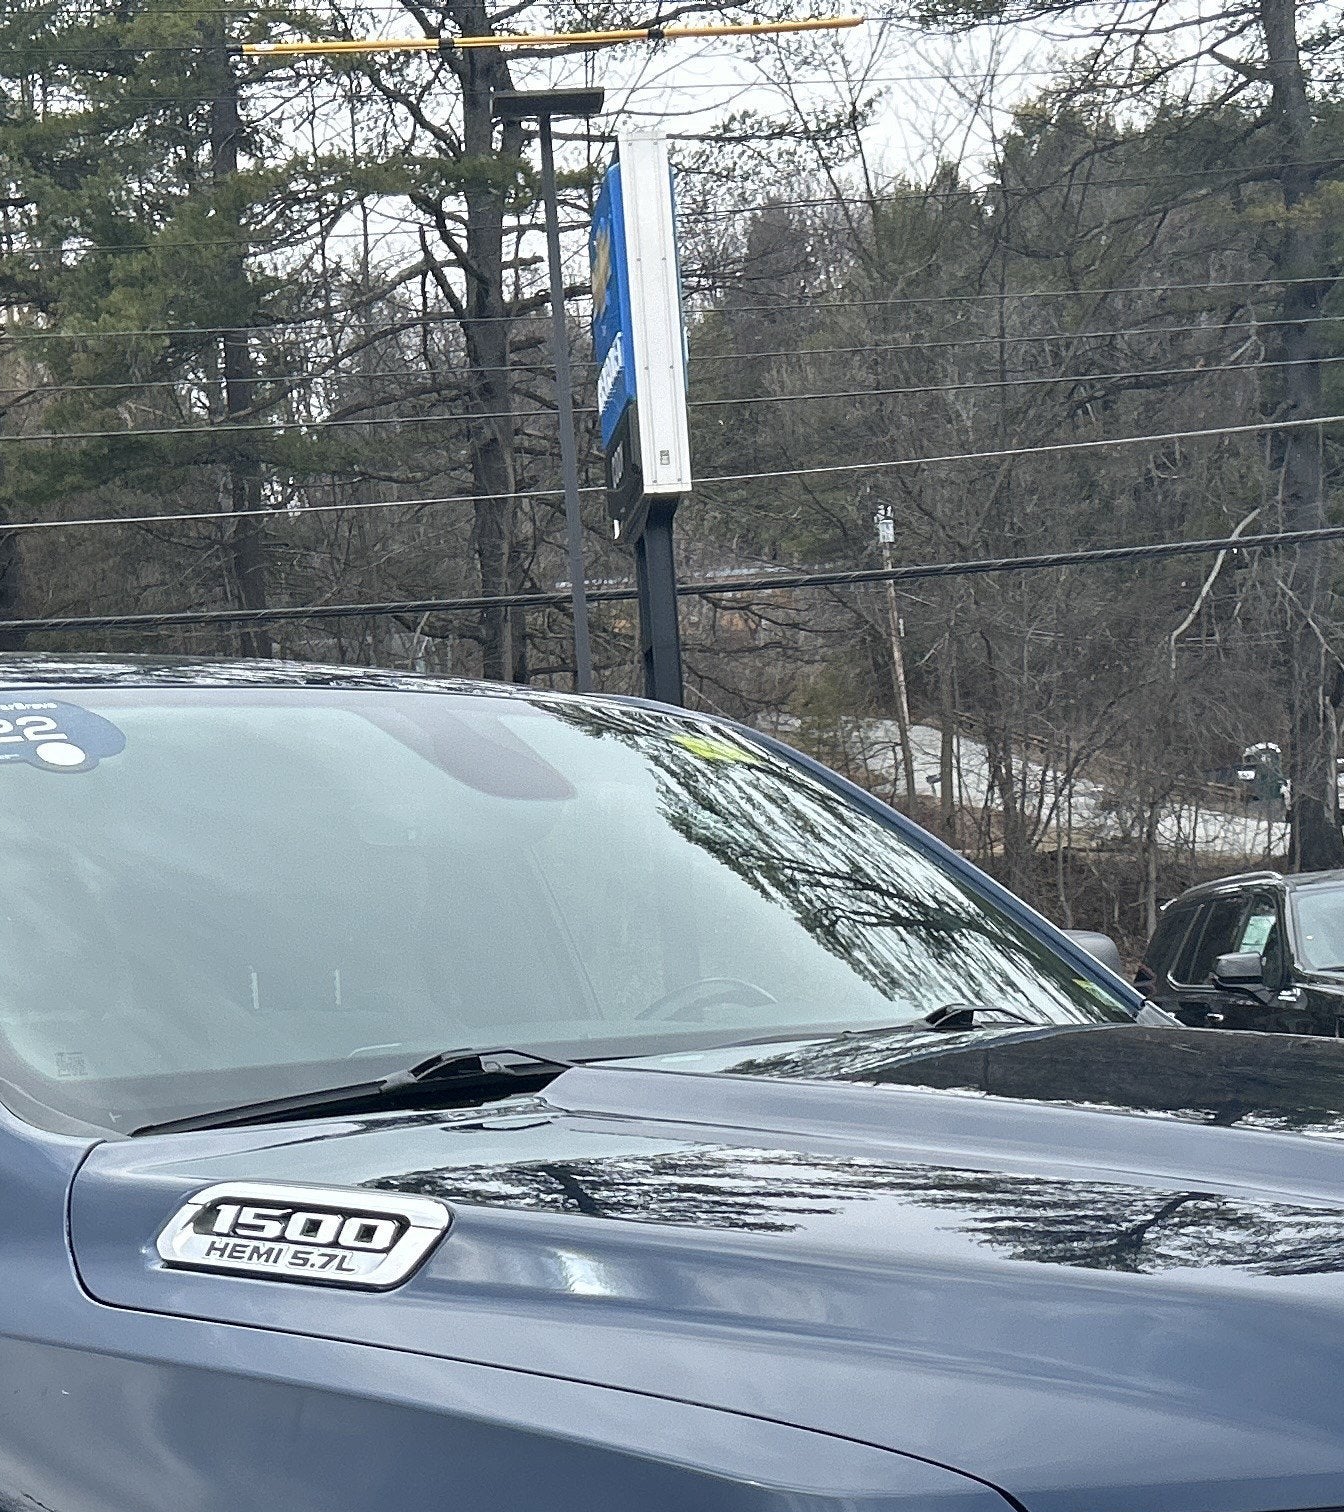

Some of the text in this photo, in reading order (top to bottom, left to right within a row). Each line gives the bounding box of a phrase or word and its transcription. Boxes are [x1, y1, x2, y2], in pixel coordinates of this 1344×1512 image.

[211, 1203, 399, 1251] 1500
[205, 1240, 356, 1273] HEMI 5.7L
